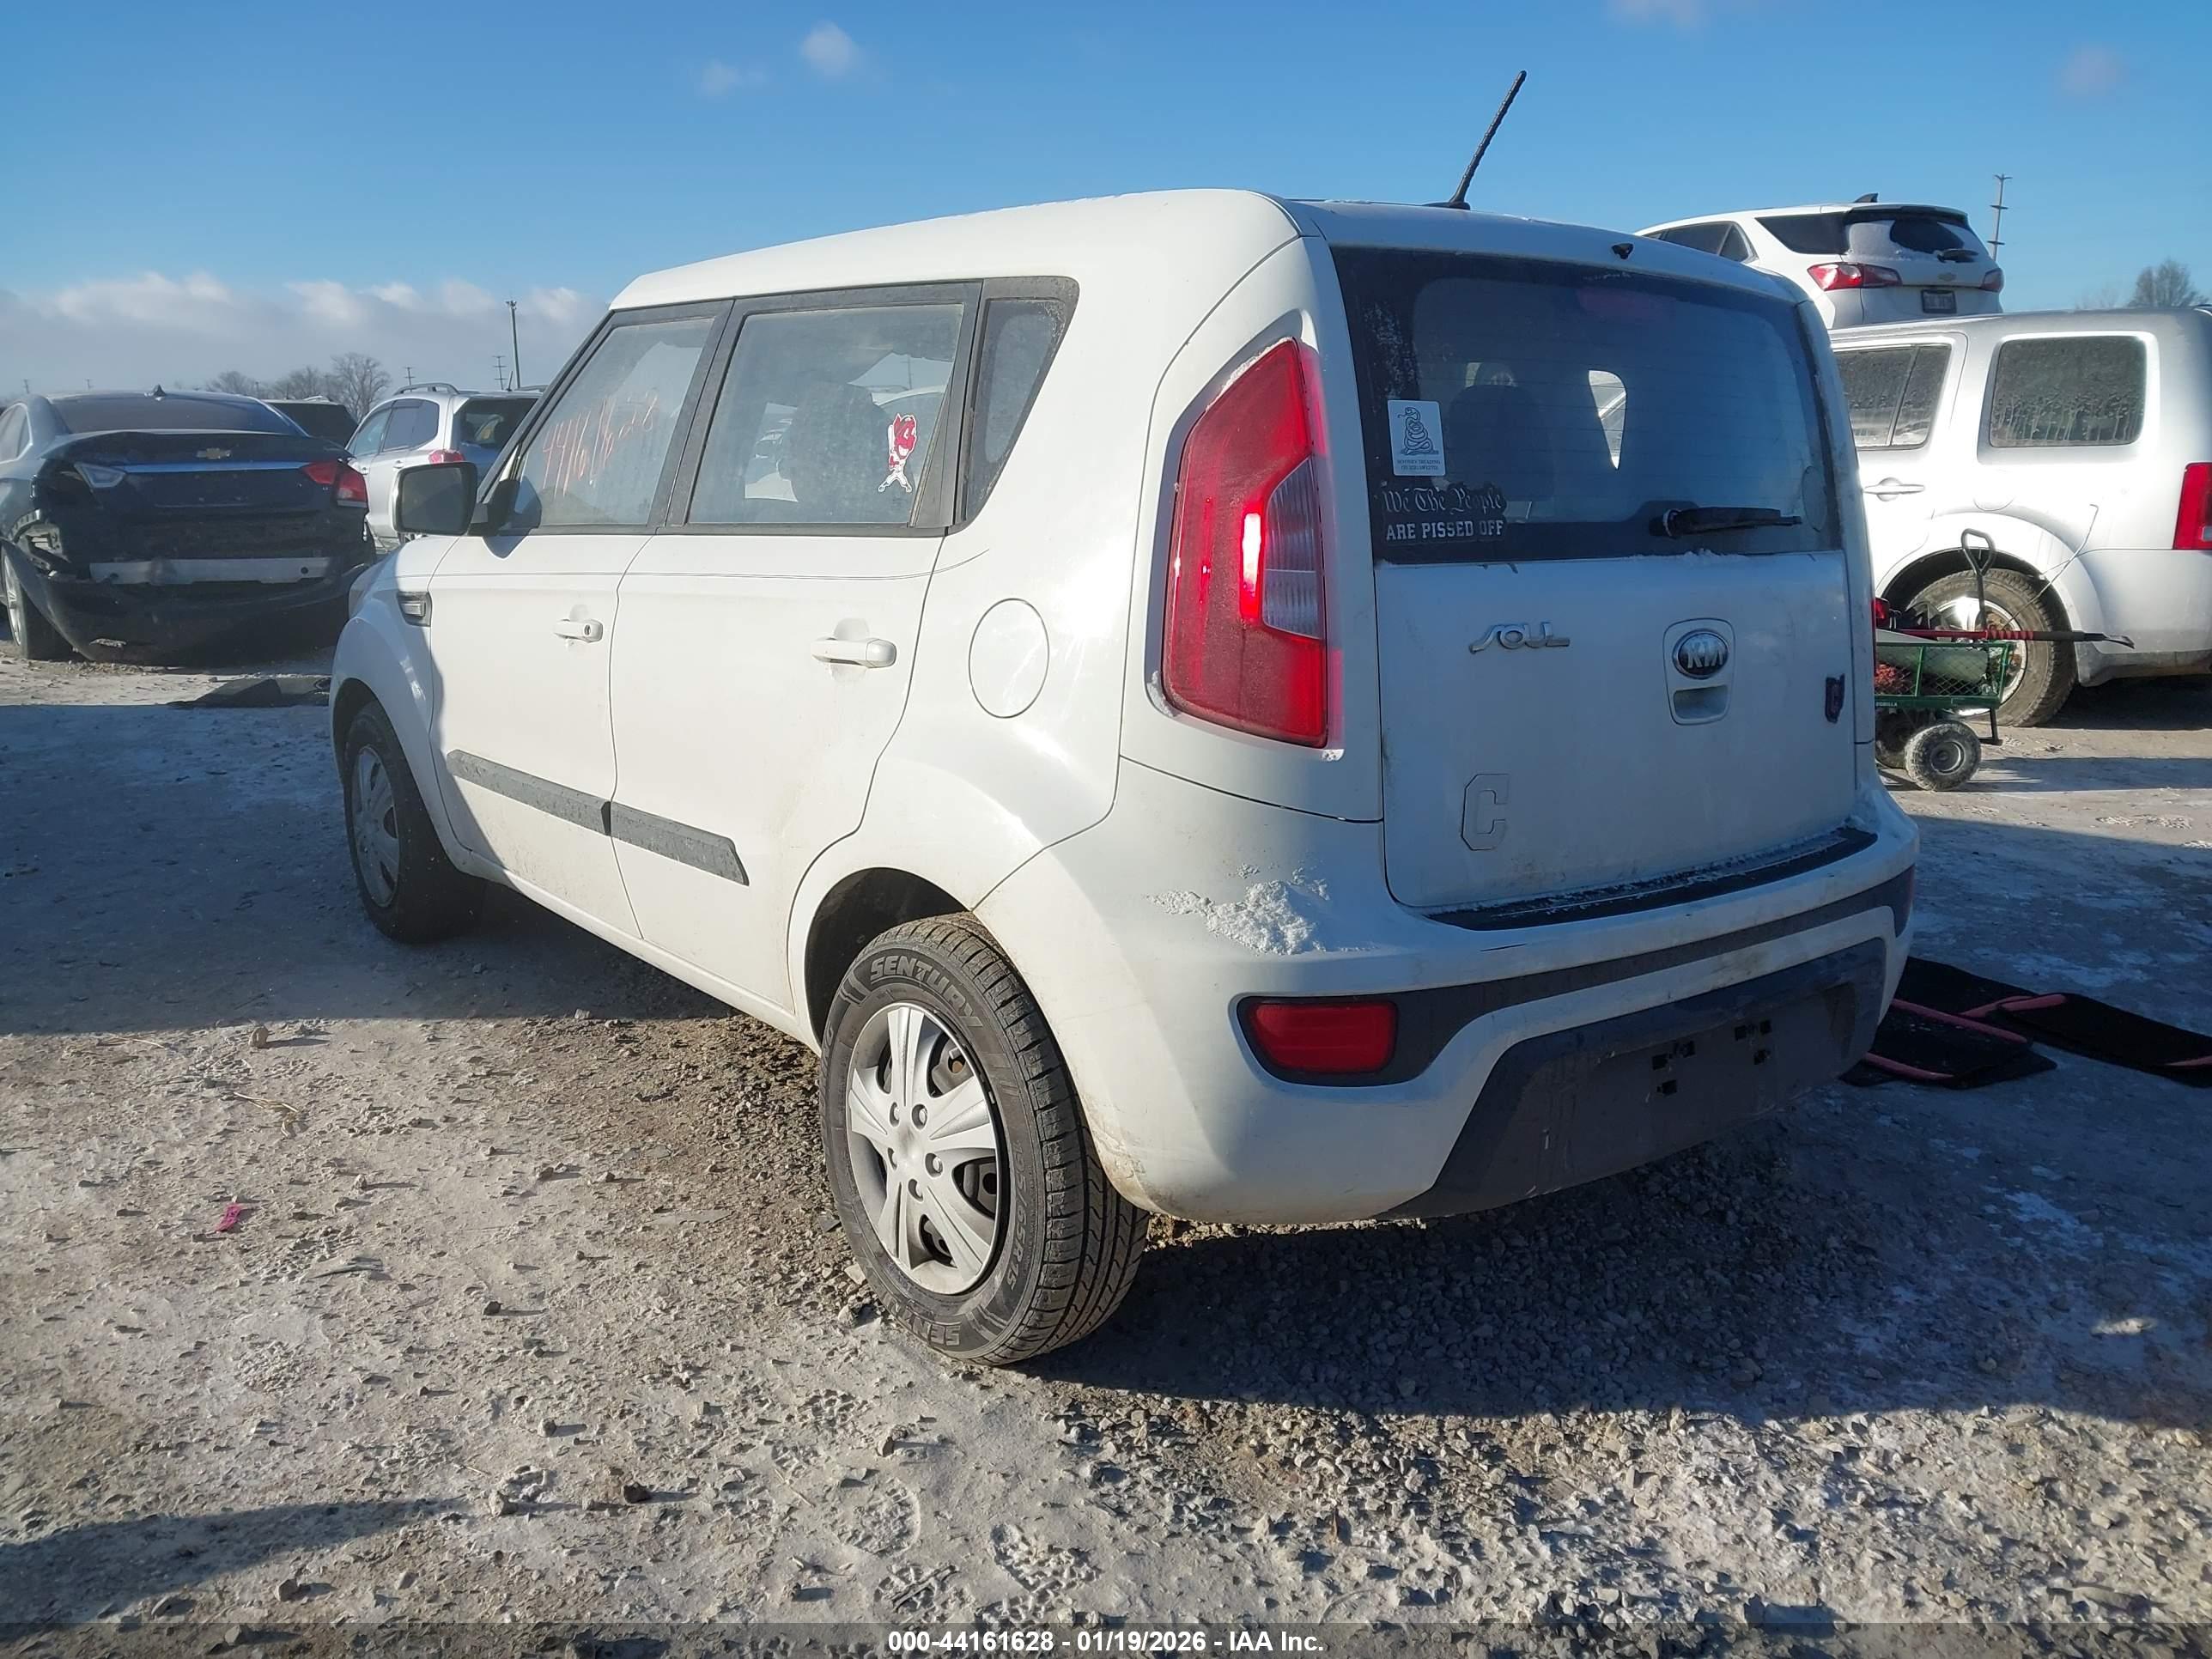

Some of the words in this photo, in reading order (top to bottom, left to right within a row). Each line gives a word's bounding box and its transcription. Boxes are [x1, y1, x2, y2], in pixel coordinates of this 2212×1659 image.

[1382, 488, 1411, 513] We
[1387, 524, 1415, 540] ARE
[1422, 521, 1474, 538] PISSED
[1480, 520, 1504, 536] OFF
[870, 955, 983, 1027] SENTURY
